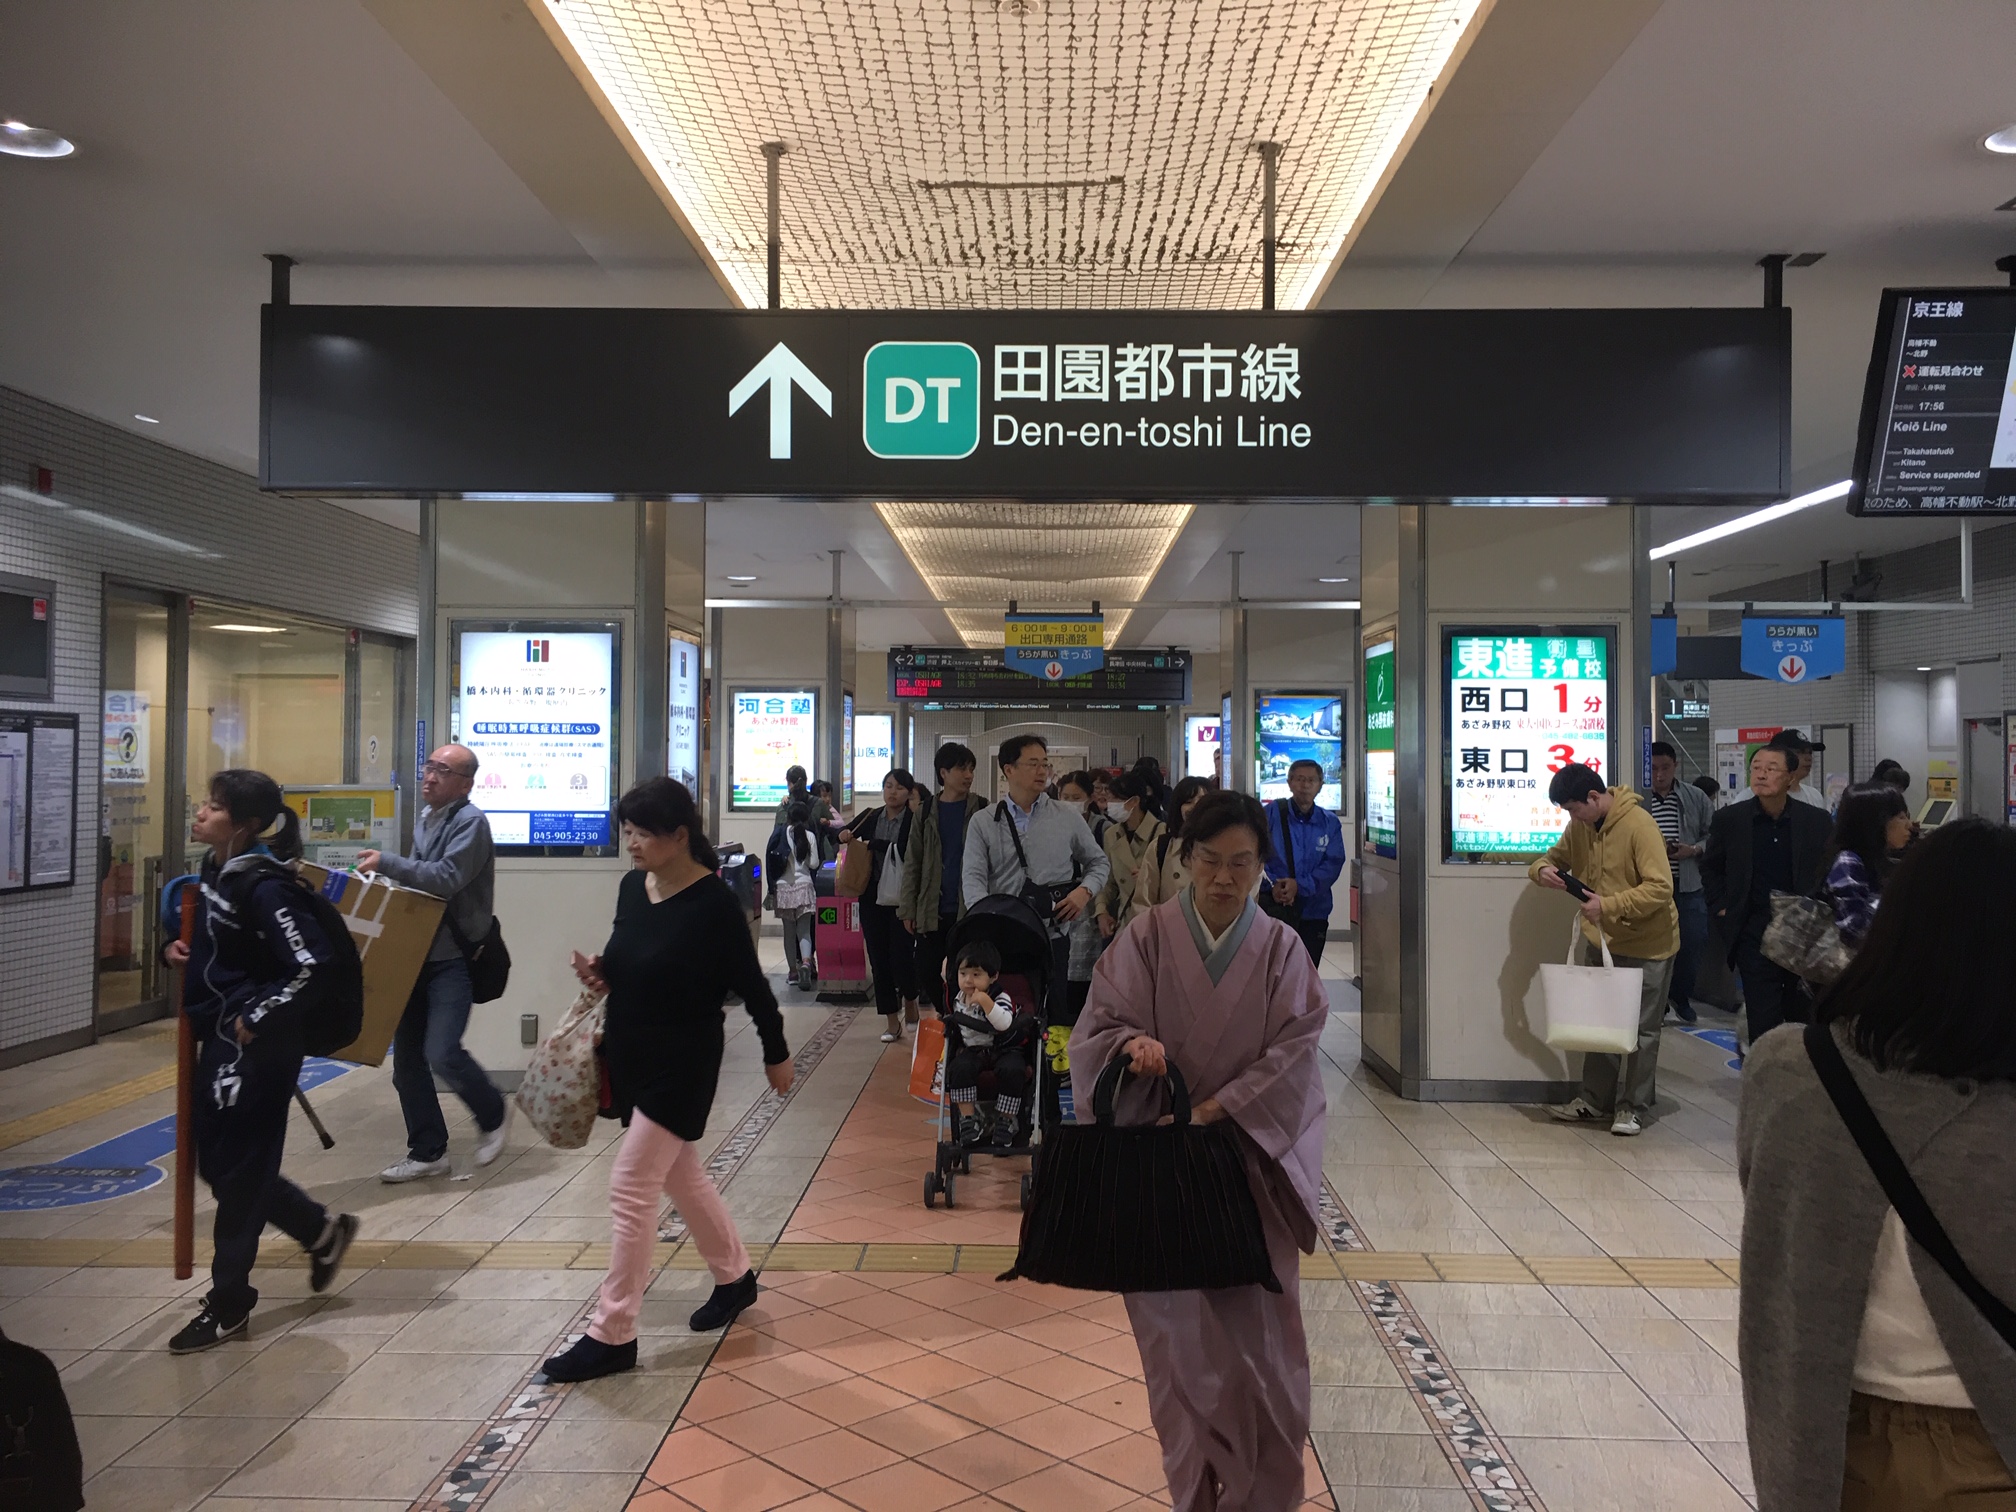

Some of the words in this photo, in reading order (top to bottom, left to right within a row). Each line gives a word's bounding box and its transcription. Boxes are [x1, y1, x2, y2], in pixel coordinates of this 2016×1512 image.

[1912, 301, 1964, 318] 京王線
[1907, 339, 1937, 347] 高幡不動
[993, 342, 1302, 403] 田園都市線
[1918, 365, 1984, 377] 運転見合わせ
[884, 377, 961, 424] DT
[1919, 402, 1945, 411] 17:56
[993, 414, 1223, 448] Den-en-toshi
[1236, 414, 1312, 448] Line
[1922, 421, 1948, 432] Line
[1901, 459, 1927, 467] Kitano
[1899, 471, 1932, 480] Service
[1933, 470, 1981, 480] suspended
[1897, 485, 1928, 493] Passenger
[1928, 485, 1945, 493] injury
[1768, 626, 1817, 637] うらが黒い
[1020, 633, 1087, 645] 出口専用通路
[1772, 639, 1813, 652] きっぷ
[906, 654, 914, 666] 2
[1018, 650, 1057, 659] うらが黒い
[1060, 649, 1092, 660] きっぷ
[1457, 638, 1533, 679] 東進
[1539, 659, 1602, 679] 予備校
[466, 685, 606, 696] 橋本内科・循環器クリニック
[1459, 686, 1529, 713] 西口
[738, 698, 811, 715] 河合塾
[1670, 699, 1676, 715] 1
[476, 723, 596, 735] 睡眠時無呼吸症候群(SAS)
[1461, 719, 1511, 730] あざみ野校
[1459, 746, 1529, 773] 東口
[1455, 779, 1536, 789] あざみ野駅東口校
[533, 831, 598, 840] 045-905-2530
